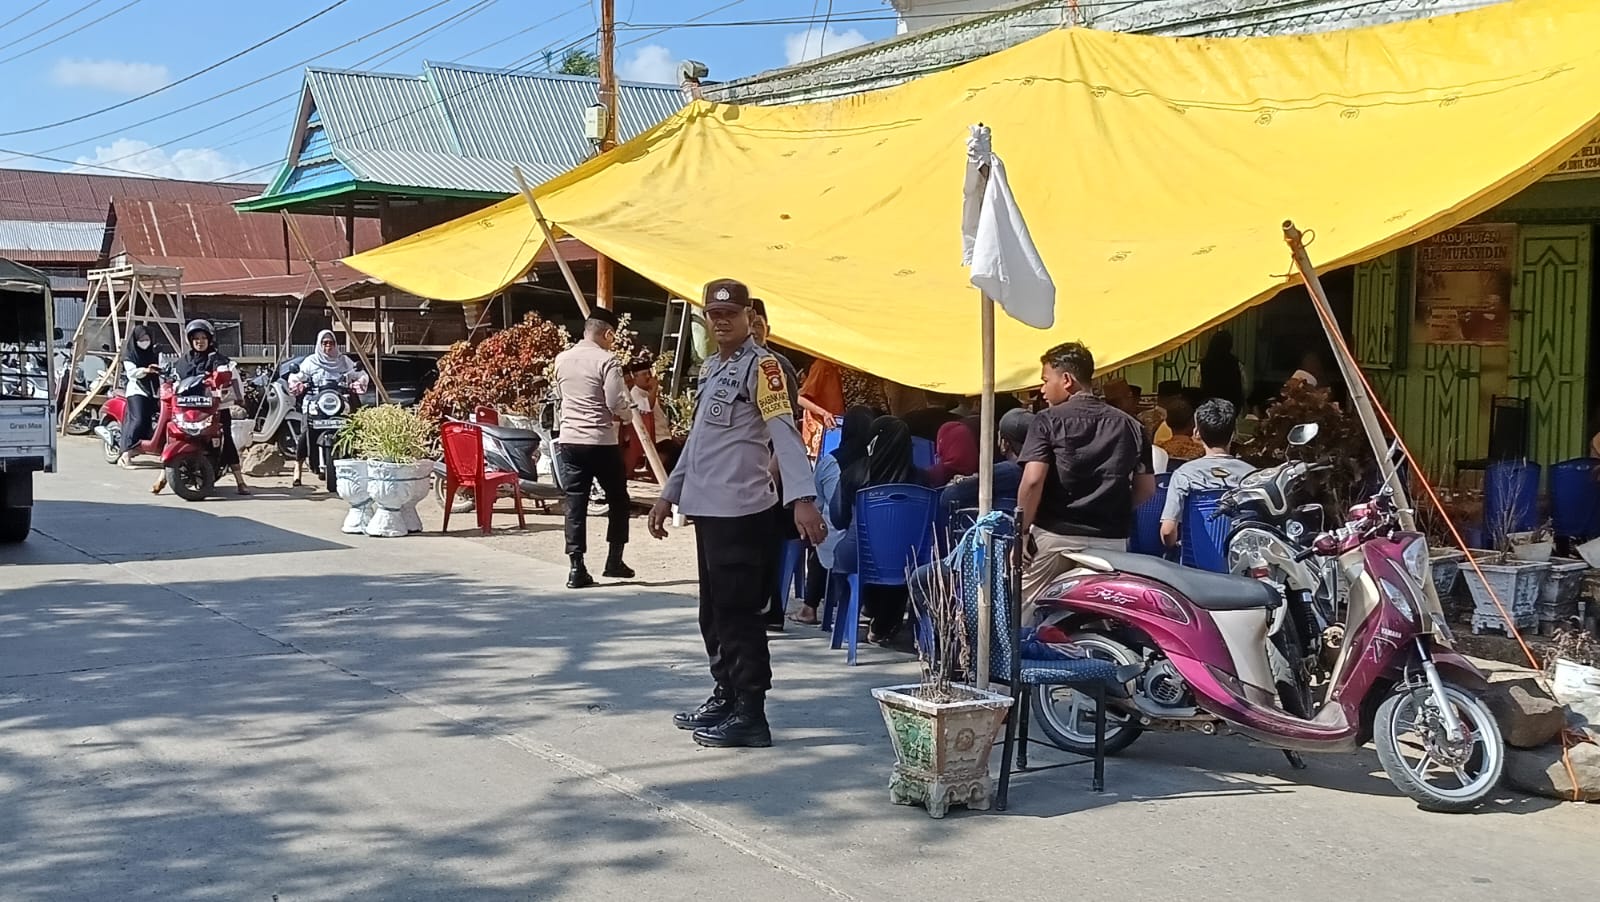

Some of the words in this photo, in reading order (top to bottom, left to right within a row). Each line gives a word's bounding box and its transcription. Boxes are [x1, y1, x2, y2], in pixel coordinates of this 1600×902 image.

[1431, 232, 1462, 244] MADU
[1465, 230, 1500, 243] HUTAN
[1424, 246, 1508, 259] AL-MURSYIDIN
[718, 377, 740, 388] POLRI
[1381, 627, 1402, 638] YAMAHA
